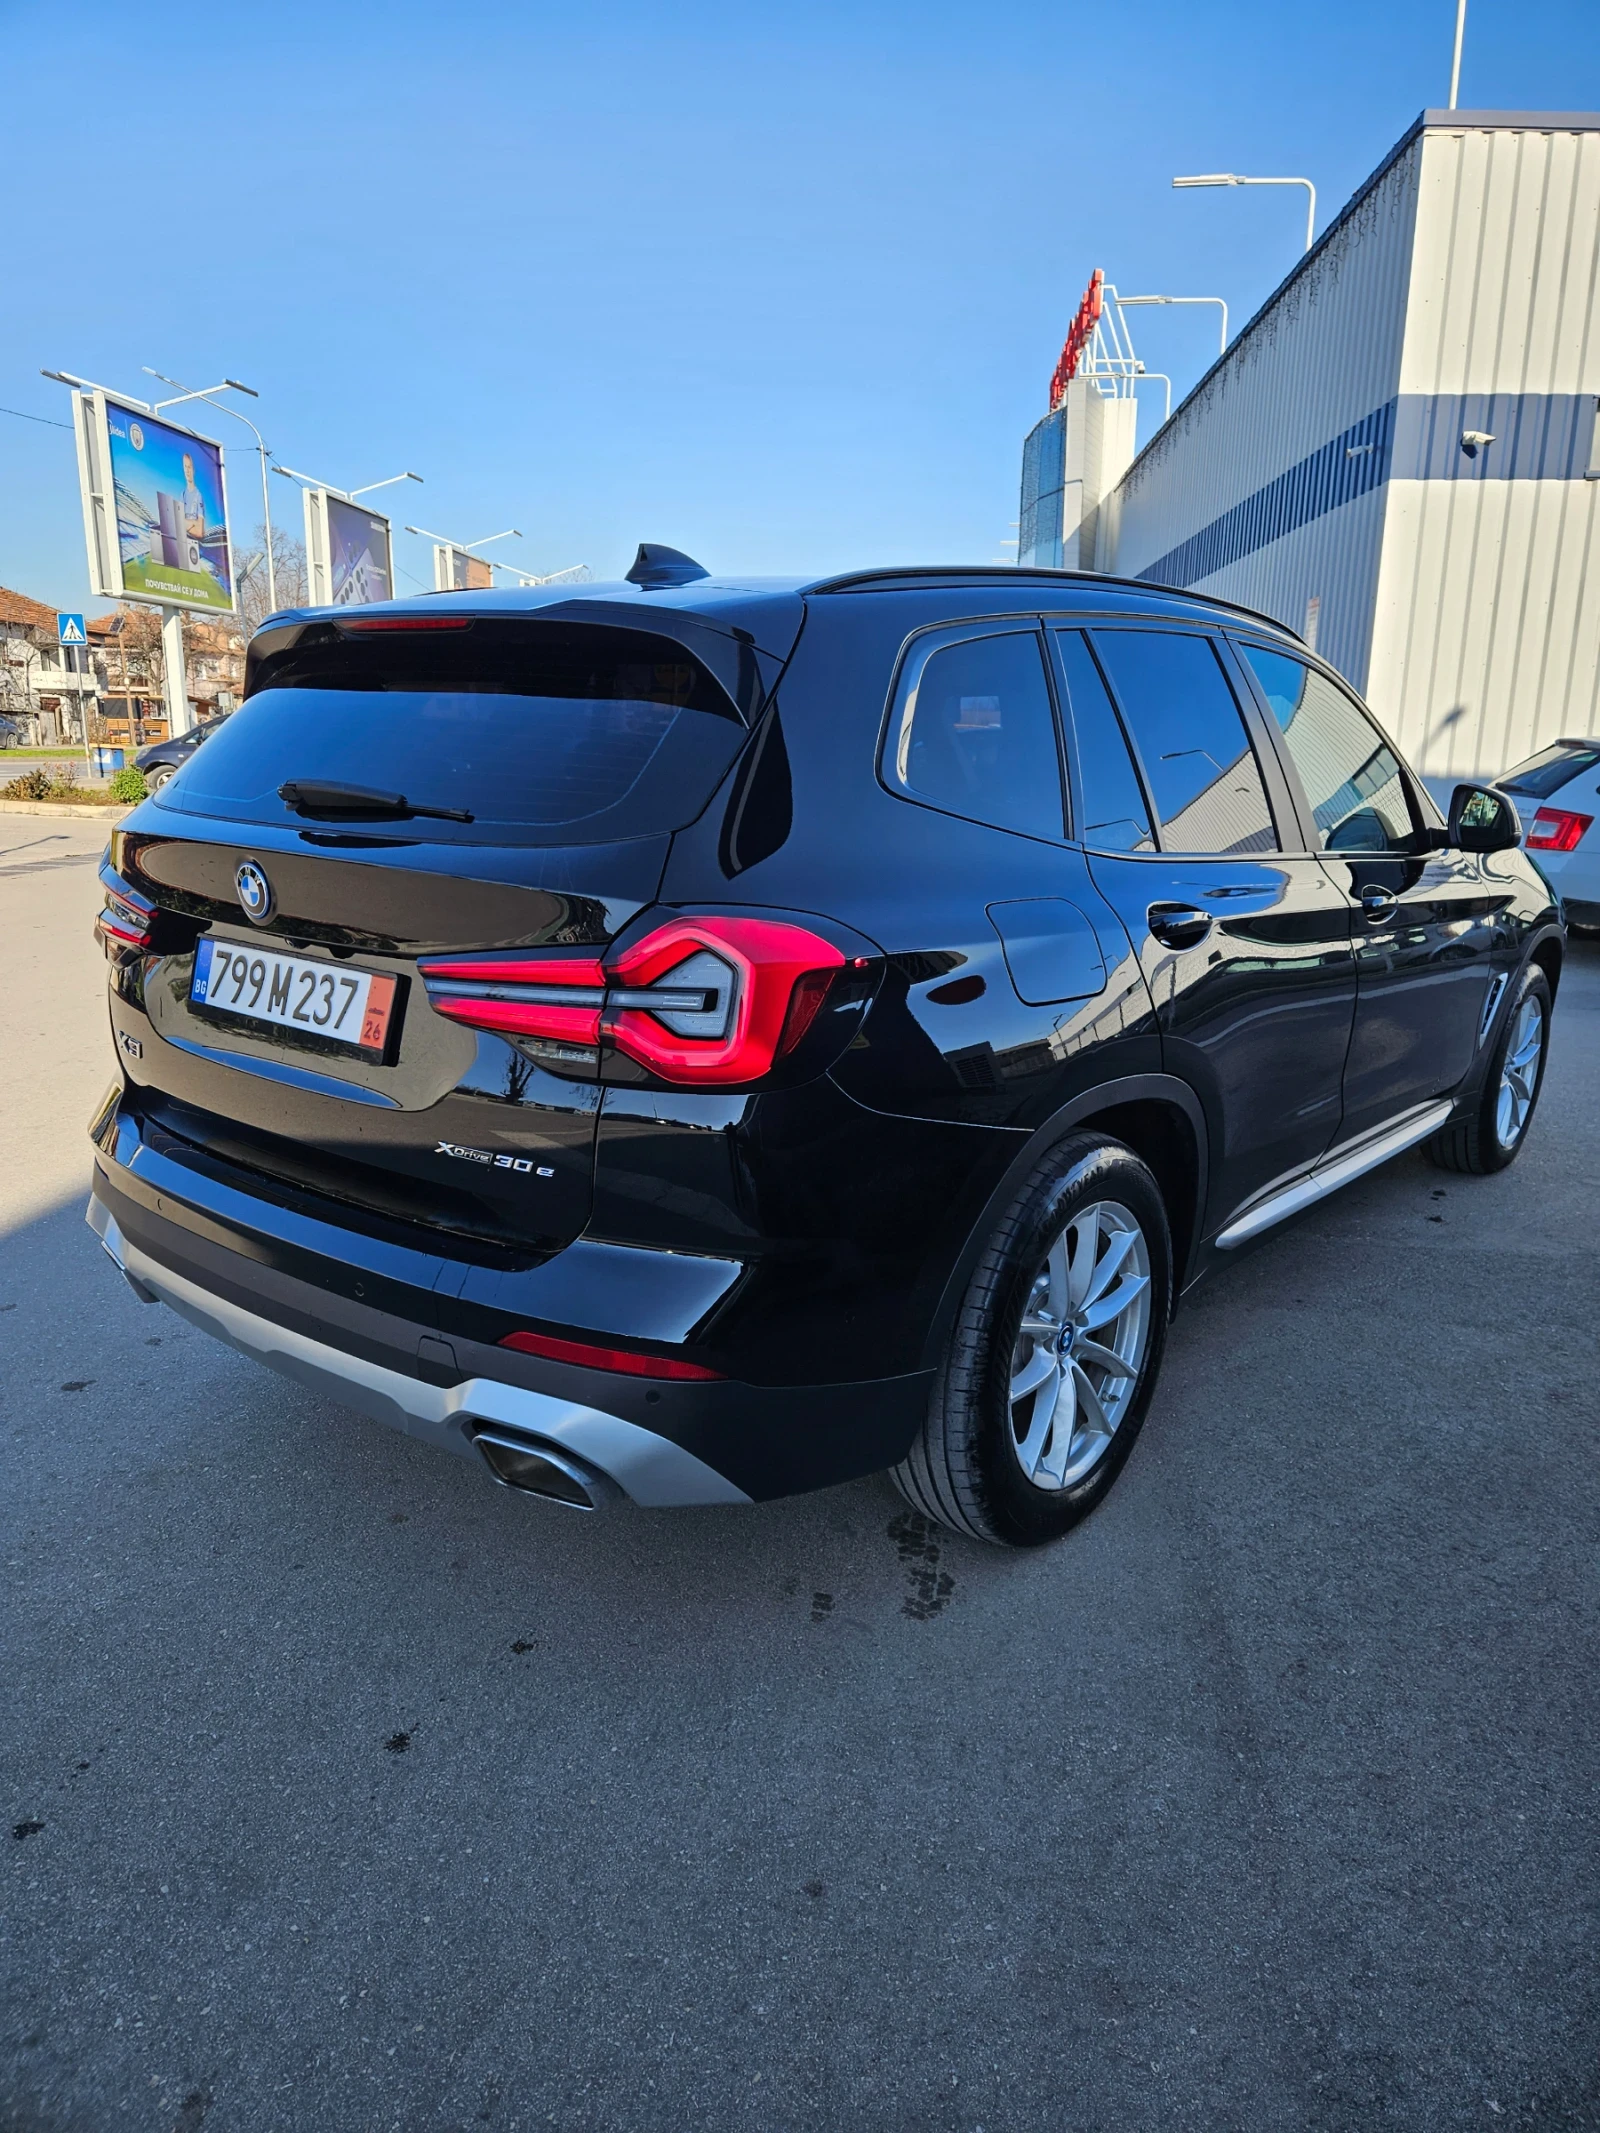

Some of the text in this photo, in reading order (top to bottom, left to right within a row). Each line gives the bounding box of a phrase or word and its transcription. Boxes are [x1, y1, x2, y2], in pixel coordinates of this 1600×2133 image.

[145, 578, 181, 594] ПОЧУВСТВАЙ
[182, 585, 190, 595] СЕ
[193, 589, 209, 599] ДОМА
[238, 866, 262, 885] BMW
[194, 979, 207, 995] BG
[364, 1020, 381, 1041] 26
